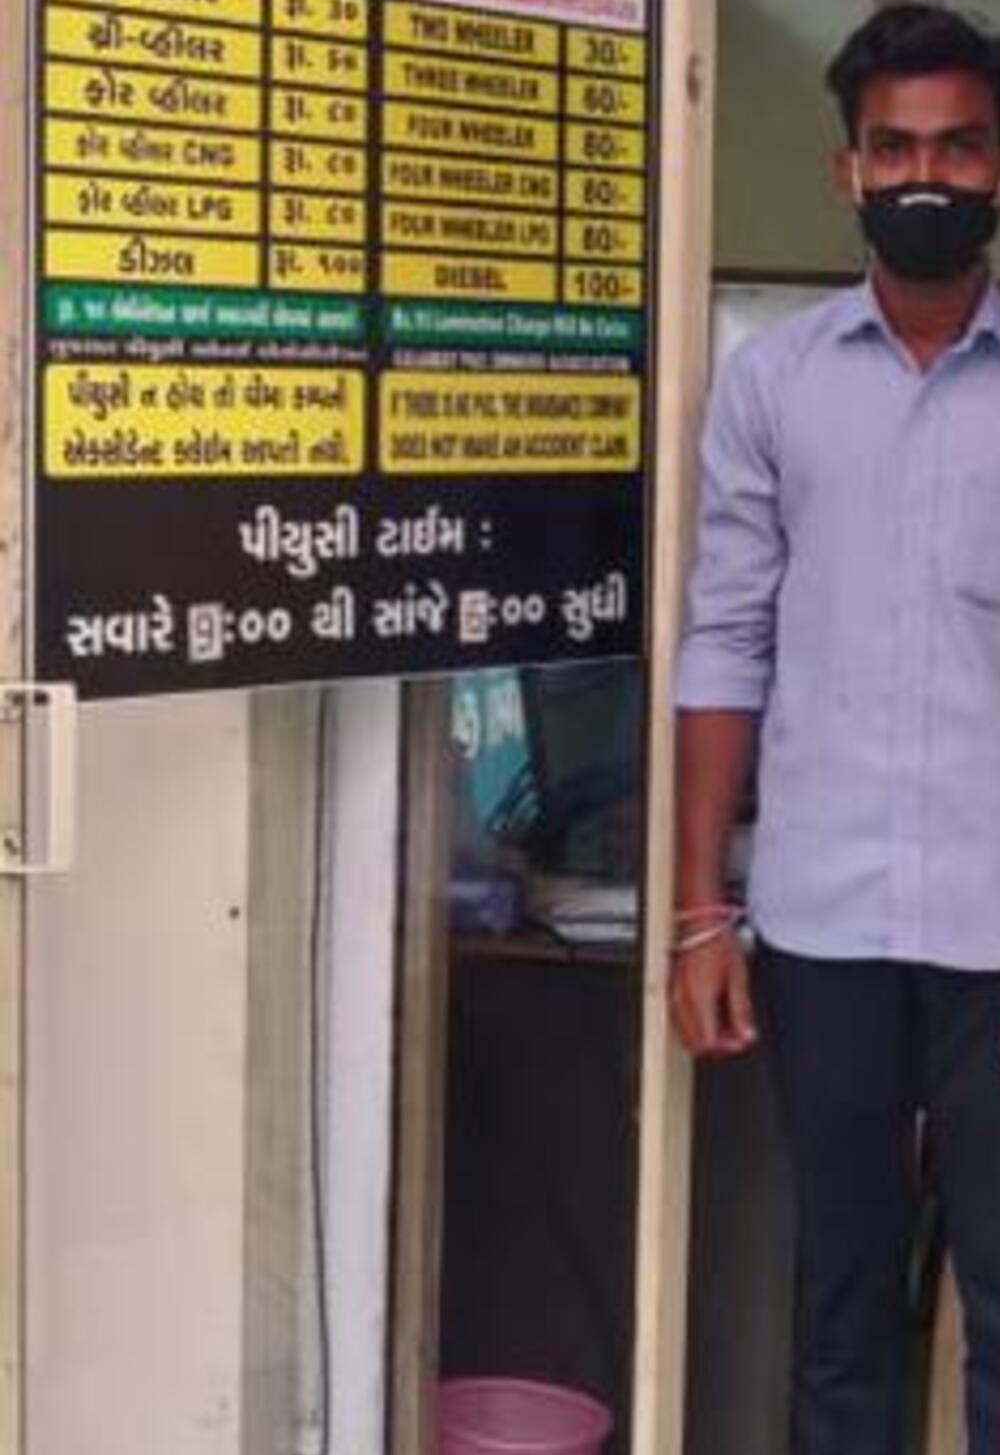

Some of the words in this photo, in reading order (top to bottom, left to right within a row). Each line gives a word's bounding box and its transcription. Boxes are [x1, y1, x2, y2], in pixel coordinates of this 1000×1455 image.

[410, 12, 448, 41] TWO
[454, 19, 534, 52] WHEELER
[402, 62, 458, 92] THREE
[464, 73, 540, 101] WHEELER
[407, 114, 451, 141] FOUR
[459, 119, 534, 149] WHEELER
[182, 138, 235, 167] CNG
[391, 160, 432, 186] FOUR
[438, 167, 514, 193] WHEELER
[519, 173, 551, 199] CNG
[186, 195, 233, 221] LPG
[390, 211, 434, 235] FOUR
[440, 216, 515, 243] WHEELER
[519, 221, 550, 247] LPG
[434, 265, 508, 291] DIESEL
[239, 504, 360, 577] પીયુસી
[66, 594, 175, 657] સવારે
[561, 572, 627, 641] સુધી
